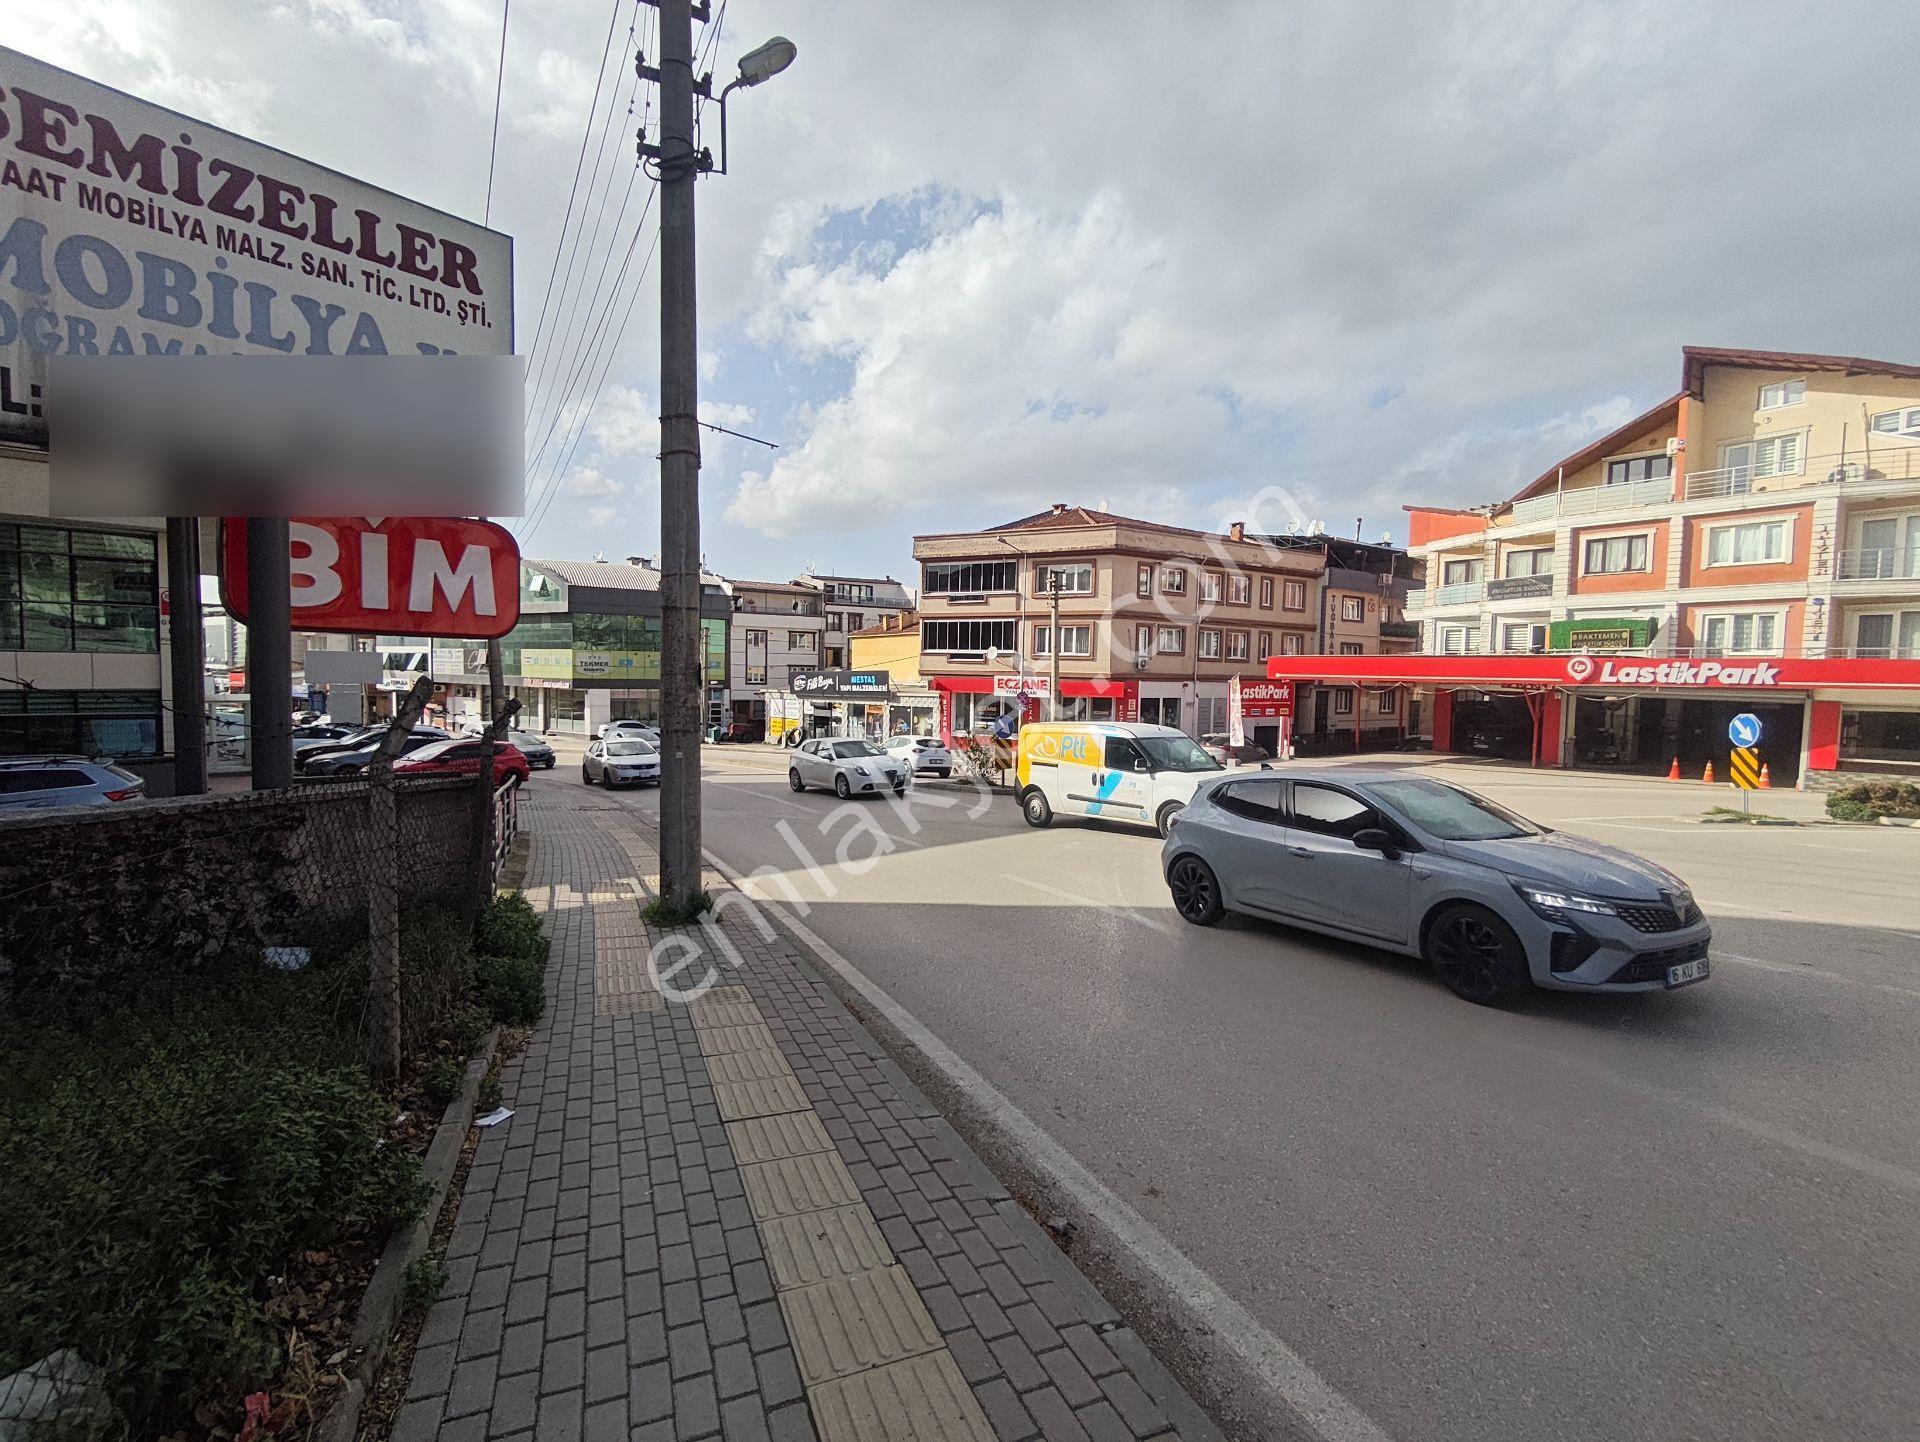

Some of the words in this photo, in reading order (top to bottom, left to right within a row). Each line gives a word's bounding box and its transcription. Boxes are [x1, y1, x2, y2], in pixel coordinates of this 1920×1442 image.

[0, 83, 483, 296] EMİZELLER
[78, 181, 208, 245] MOBİLYA
[216, 224, 293, 270] MALZ.
[301, 252, 354, 288] SAN.
[361, 269, 402, 302] TİC.
[409, 285, 451, 316] LTD.
[457, 300, 492, 328] ŞTİ.
[289, 517, 497, 617] BİM
[1578, 632, 1620, 641] BAKTEMEN
[997, 678, 1048, 691] ECZANE
[1600, 661, 1780, 685] LastikPark
[1061, 735, 1087, 759] Ptt
